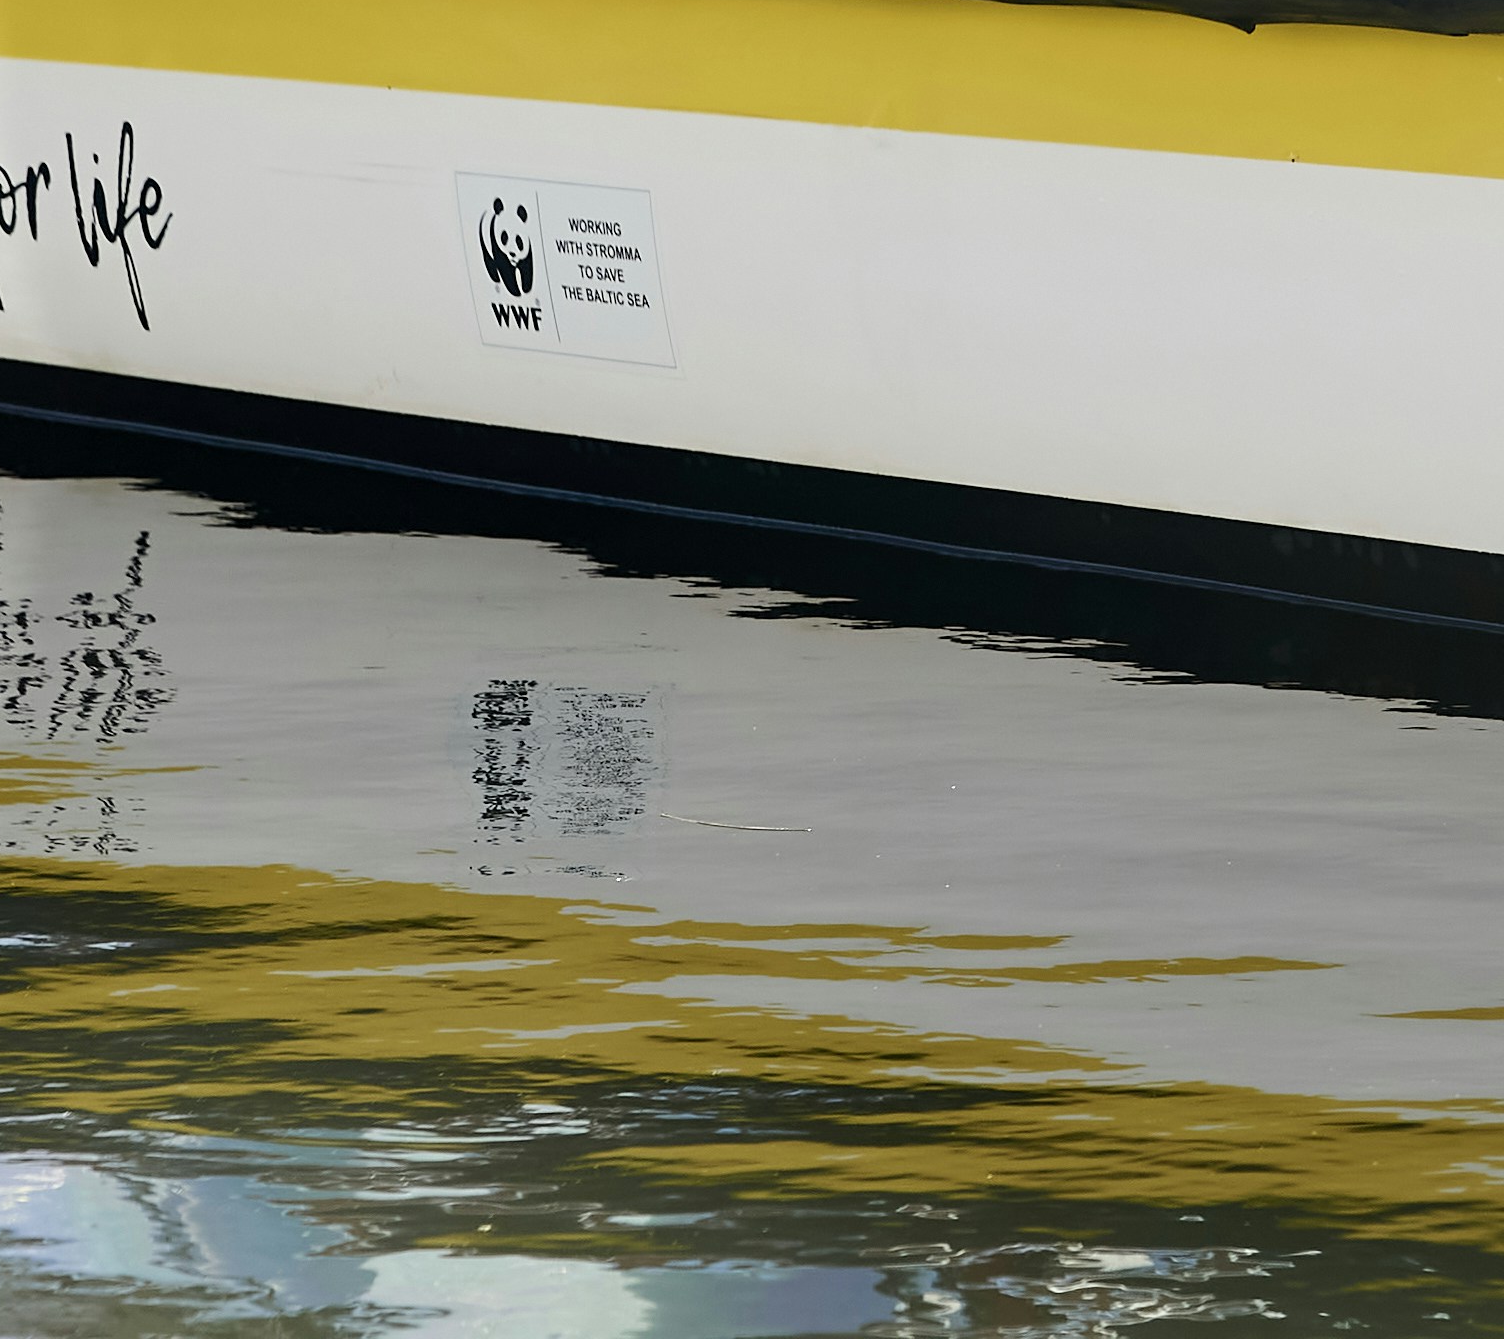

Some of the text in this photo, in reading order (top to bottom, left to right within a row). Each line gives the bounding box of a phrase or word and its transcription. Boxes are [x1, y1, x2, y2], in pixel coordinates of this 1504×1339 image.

[66, 121, 173, 331] life
[568, 218, 622, 237] WORKING
[556, 239, 642, 261] WITH STROMMA
[578, 264, 625, 283] TO SAVE
[562, 285, 650, 308] THE BALTIC SEA
[491, 302, 542, 331] WWF
